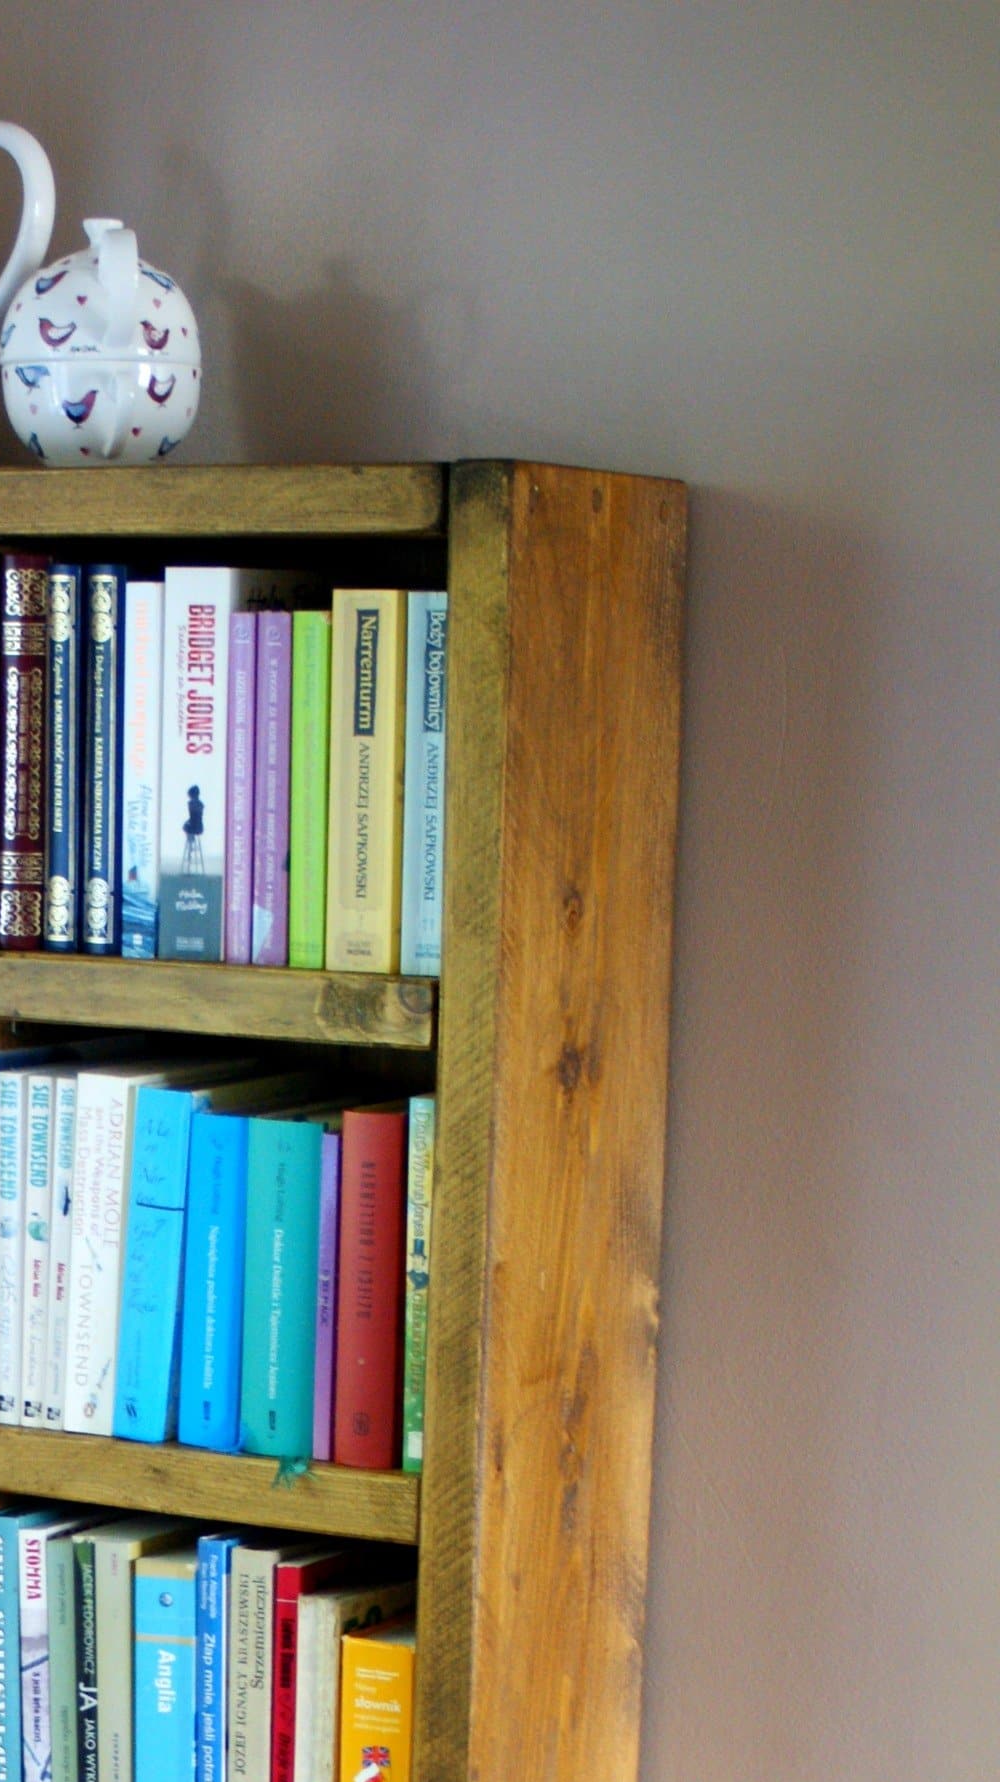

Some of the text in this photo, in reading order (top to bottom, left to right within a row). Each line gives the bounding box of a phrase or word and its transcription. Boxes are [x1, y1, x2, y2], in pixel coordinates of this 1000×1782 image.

[185, 604, 216, 754] BRIDGET JONES
[358, 615, 376, 729] Narrenturm
[424, 651, 444, 730] bojownicy
[355, 743, 371, 898] ANDRZEJ SAPKOWSKI
[423, 743, 439, 901] ANDRZEJ SAPKOWSKI
[0, 1080, 17, 1200] SUE TOWNSEND
[30, 1085, 49, 1187] SUE TOWNSEND
[58, 1088, 73, 1169] SUE TOWNSEND
[78, 1107, 91, 1142] Mass
[103, 1098, 123, 1249] ADRIAN MOLE
[74, 1264, 94, 1387] TOWNSEND
[25, 1539, 43, 1600] STOMMA
[202, 1633, 216, 1664] Złap
[237, 1573, 249, 1665] KRASZEWSKI
[251, 1575, 267, 1689] Strzemieńczyk
[78, 1683, 99, 1711] JA
[156, 1650, 176, 1713] Anglia
[202, 1712, 216, 1741] jeśli
[84, 1718, 96, 1749] JAKO
